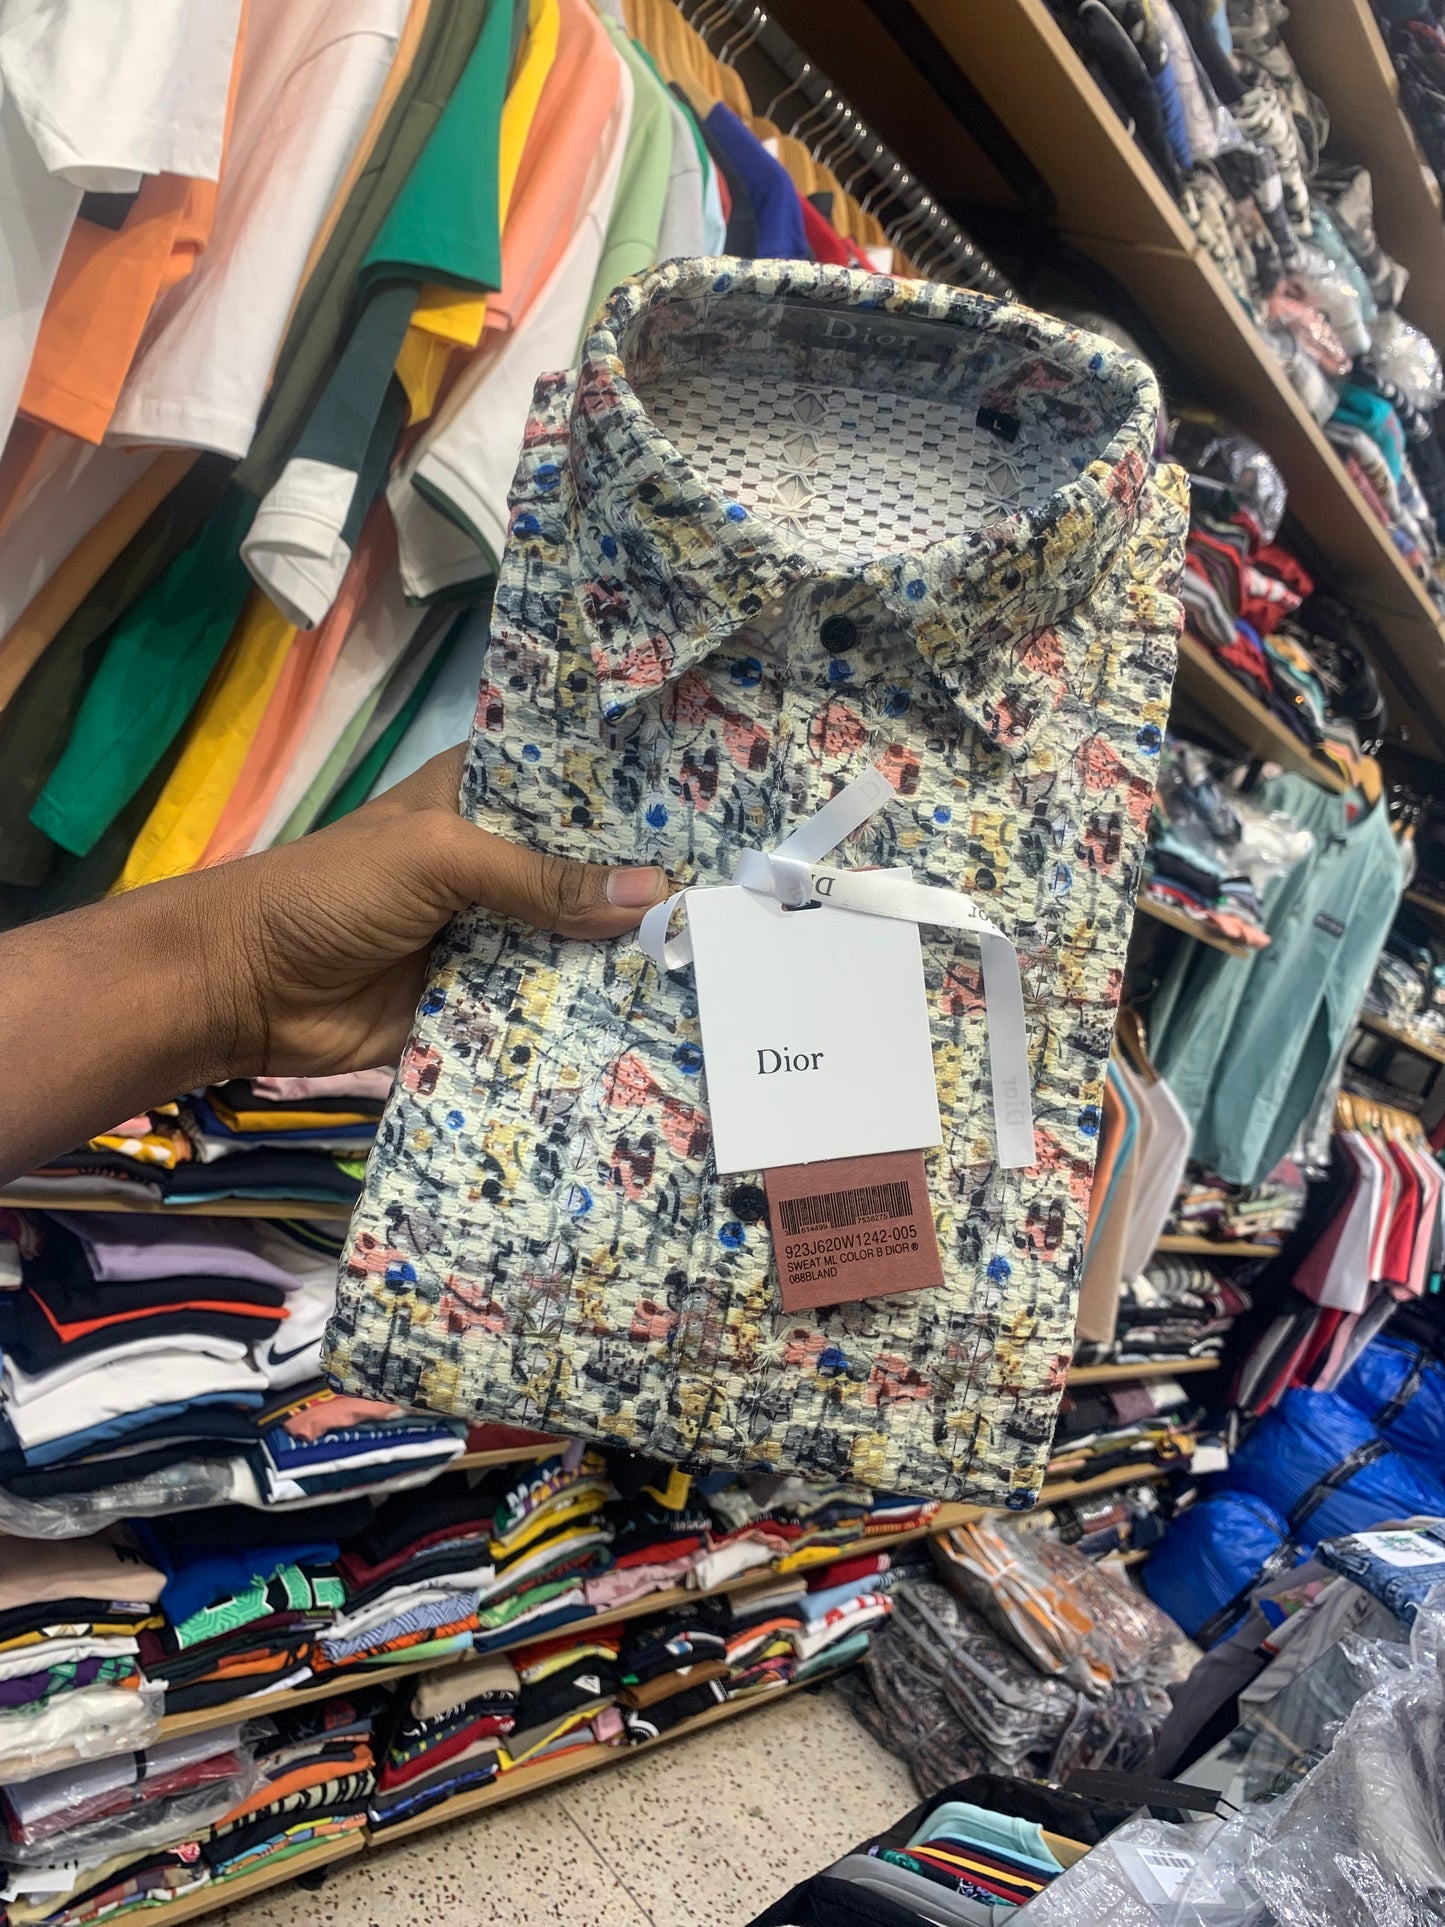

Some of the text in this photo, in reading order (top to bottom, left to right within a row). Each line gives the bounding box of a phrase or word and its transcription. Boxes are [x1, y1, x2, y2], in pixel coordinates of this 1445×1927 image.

[821, 316, 917, 346] Dior
[757, 1047, 824, 1074] Dior
[785, 1224, 917, 1259] 923J620W1242-005
[787, 1256, 821, 1273] SWEAT
[824, 1255, 838, 1266] ML
[840, 1248, 875, 1263] COLOR
[876, 1246, 883, 1257] B
[885, 1242, 910, 1256] DIOR
[789, 1266, 838, 1284] 088BLAND
